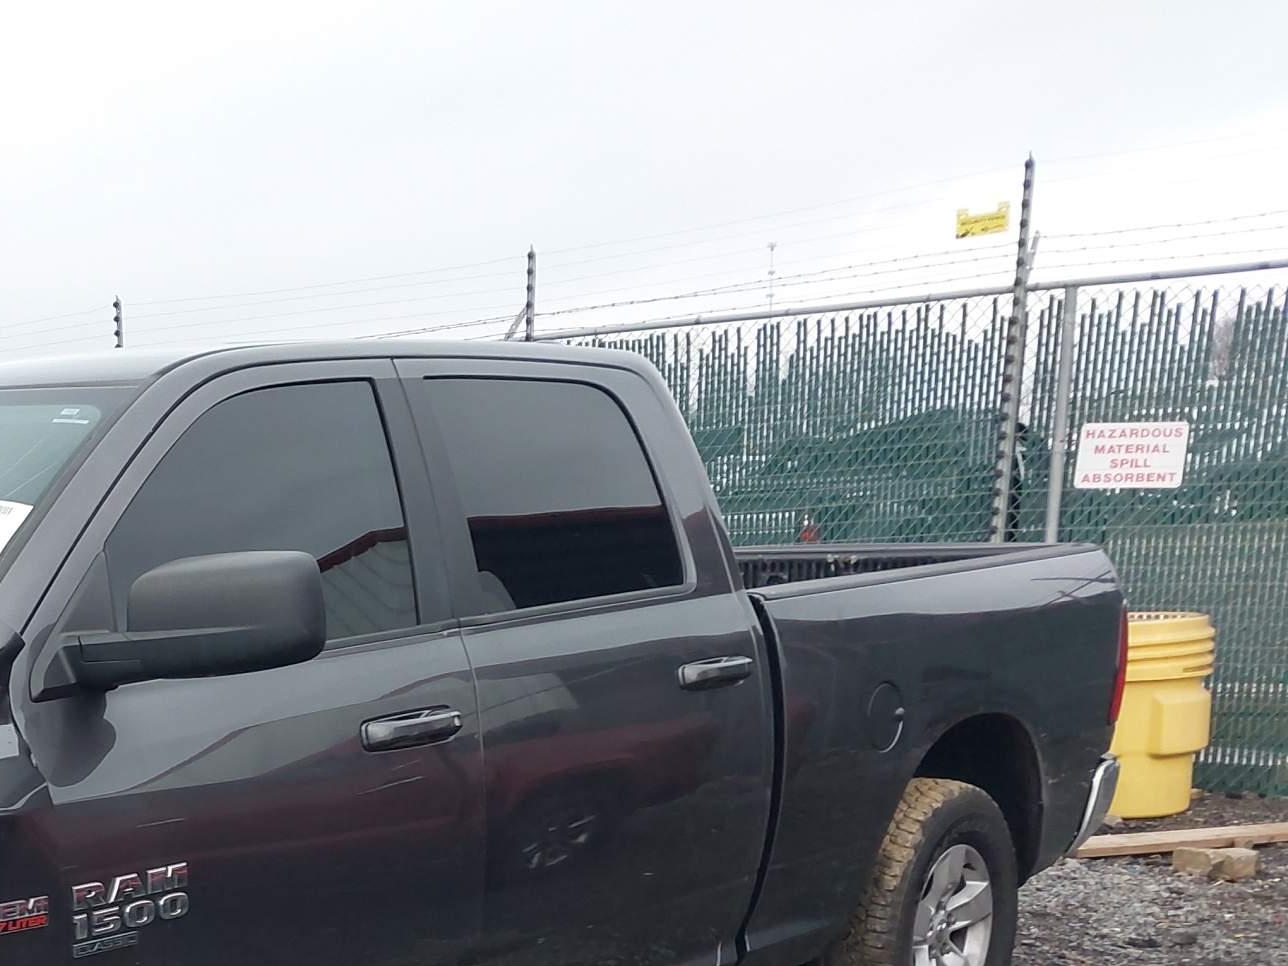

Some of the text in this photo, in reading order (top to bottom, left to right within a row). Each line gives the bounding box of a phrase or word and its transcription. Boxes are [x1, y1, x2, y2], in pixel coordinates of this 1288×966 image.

[1085, 427, 1184, 439] HAZARDOUS
[1094, 444, 1170, 454] MATERIAL
[1110, 458, 1151, 468] SPILL
[1081, 472, 1177, 483] ABSORBENT
[71, 861, 189, 911] RAM
[72, 891, 190, 940] 1500
[7, 915, 48, 933] LITER
